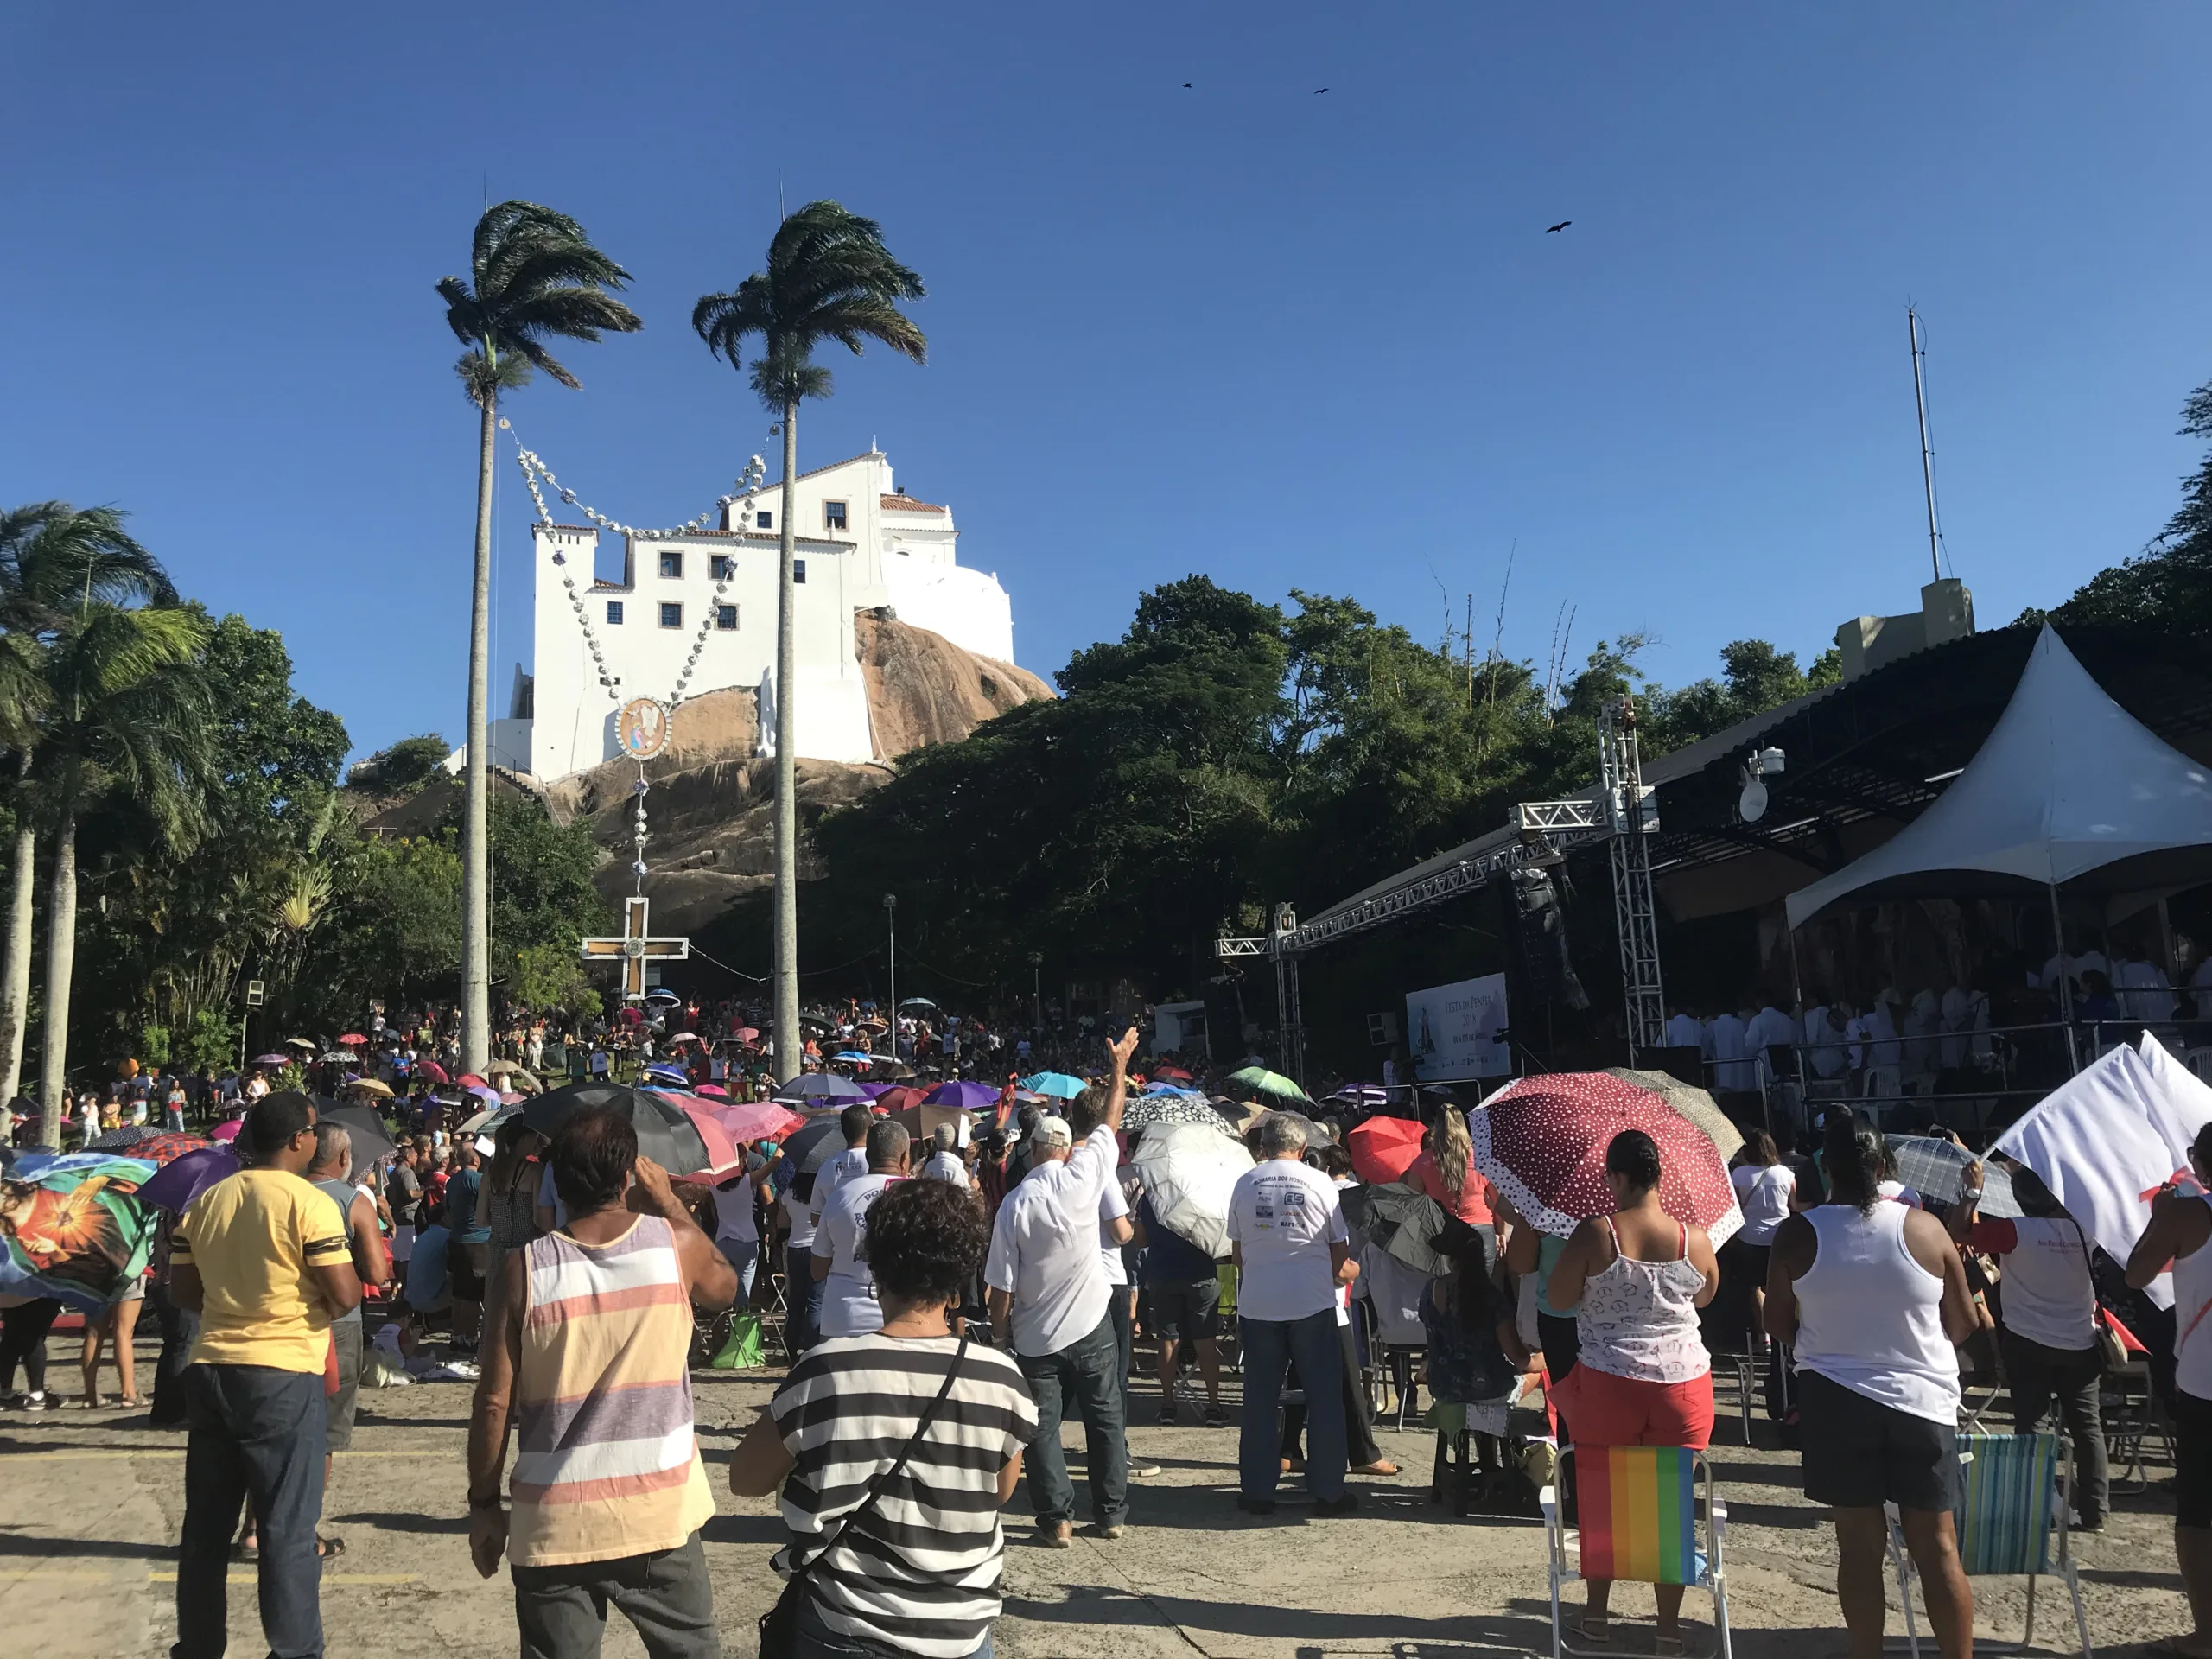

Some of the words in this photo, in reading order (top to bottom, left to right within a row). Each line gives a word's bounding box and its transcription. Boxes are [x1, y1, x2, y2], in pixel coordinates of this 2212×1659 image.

[1446, 1001, 1462, 1014] FESTA
[1471, 995, 1493, 1009] PENHA
[1463, 1013, 1476, 1027] 2018
[1254, 1176, 1276, 1185] ROMARIA
[1289, 1177, 1311, 1189] HOMENS
